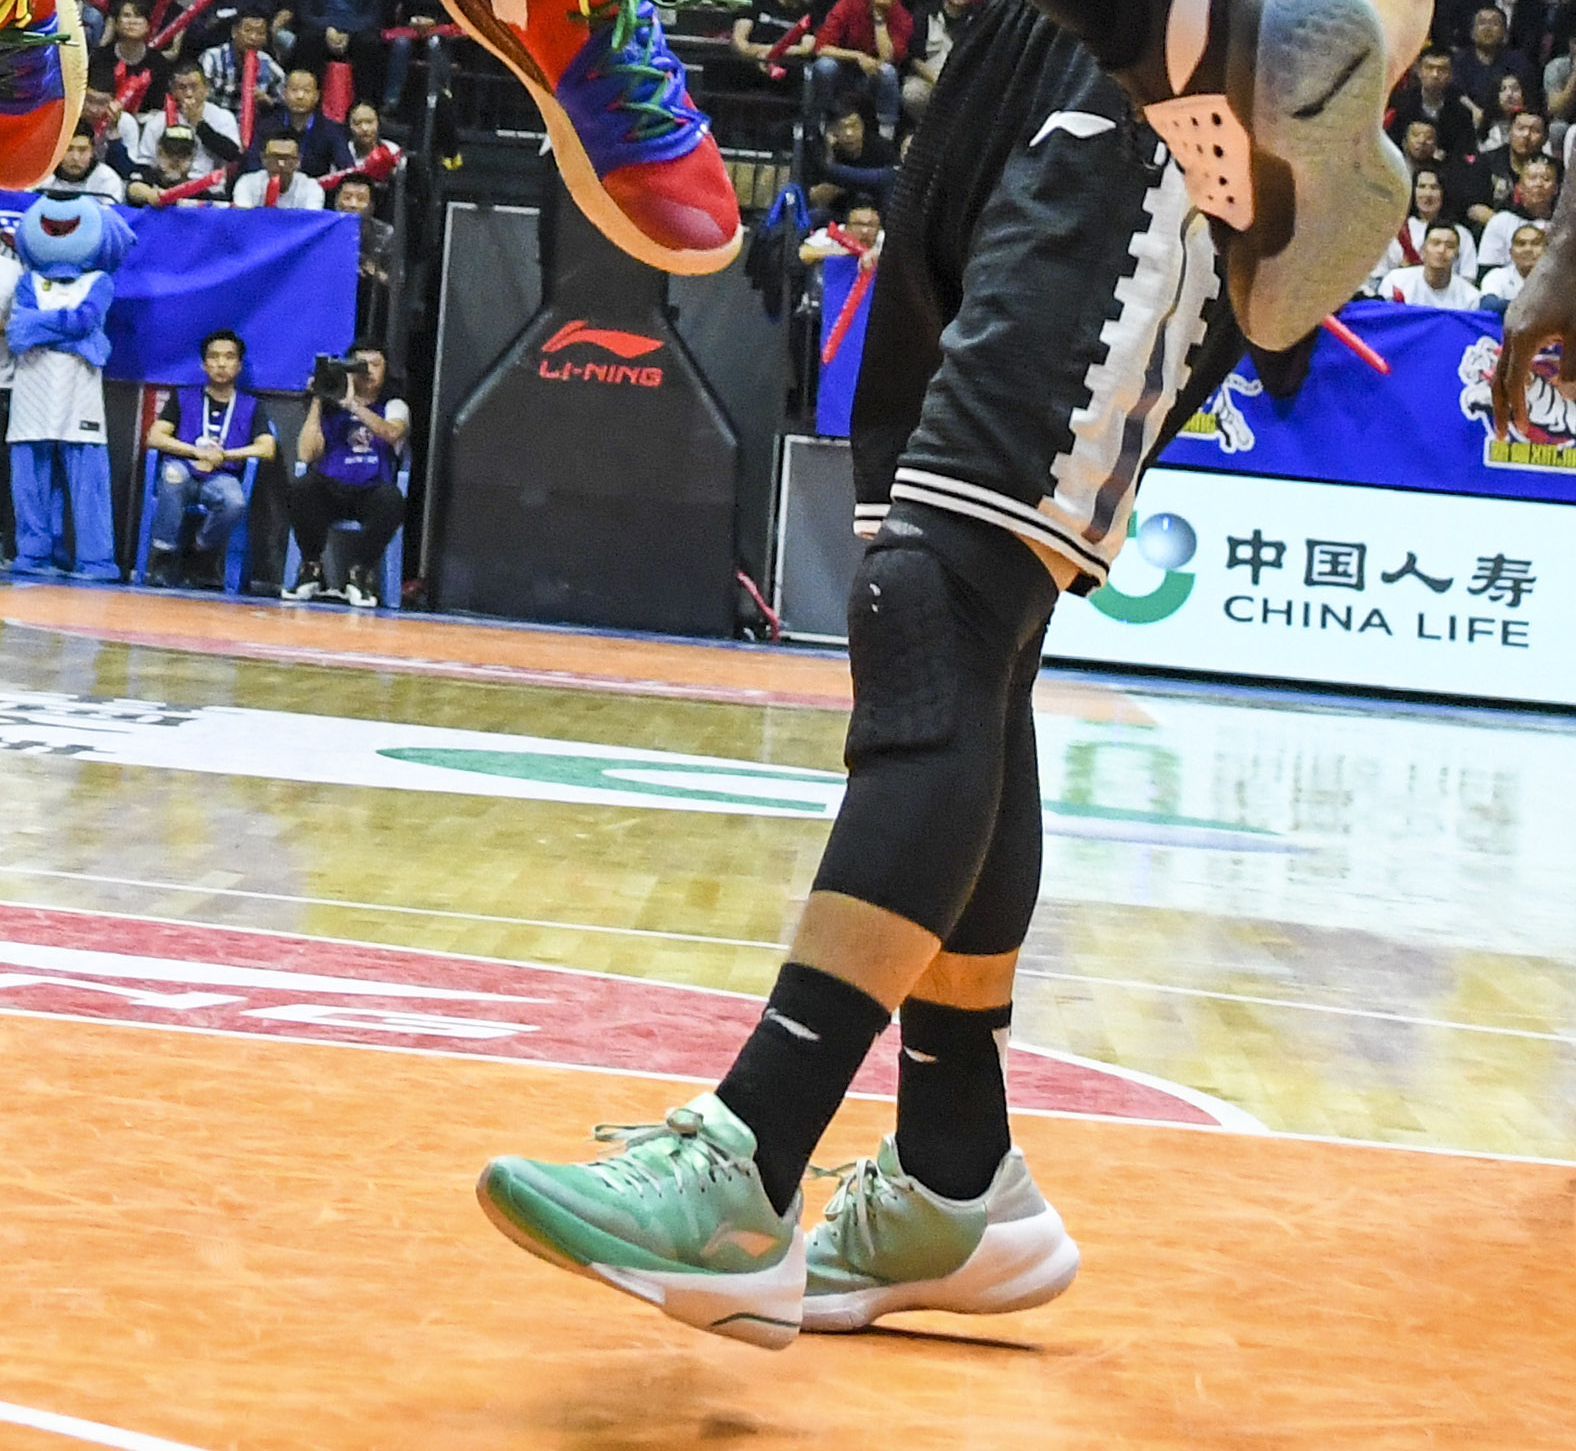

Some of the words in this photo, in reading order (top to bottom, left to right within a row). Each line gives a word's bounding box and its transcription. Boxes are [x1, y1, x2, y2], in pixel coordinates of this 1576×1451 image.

[539, 360, 665, 387] LI-NING
[1225, 528, 1538, 609] 中国人寿
[1224, 595, 1394, 636] CHINA
[1416, 612, 1531, 648] LIFE
